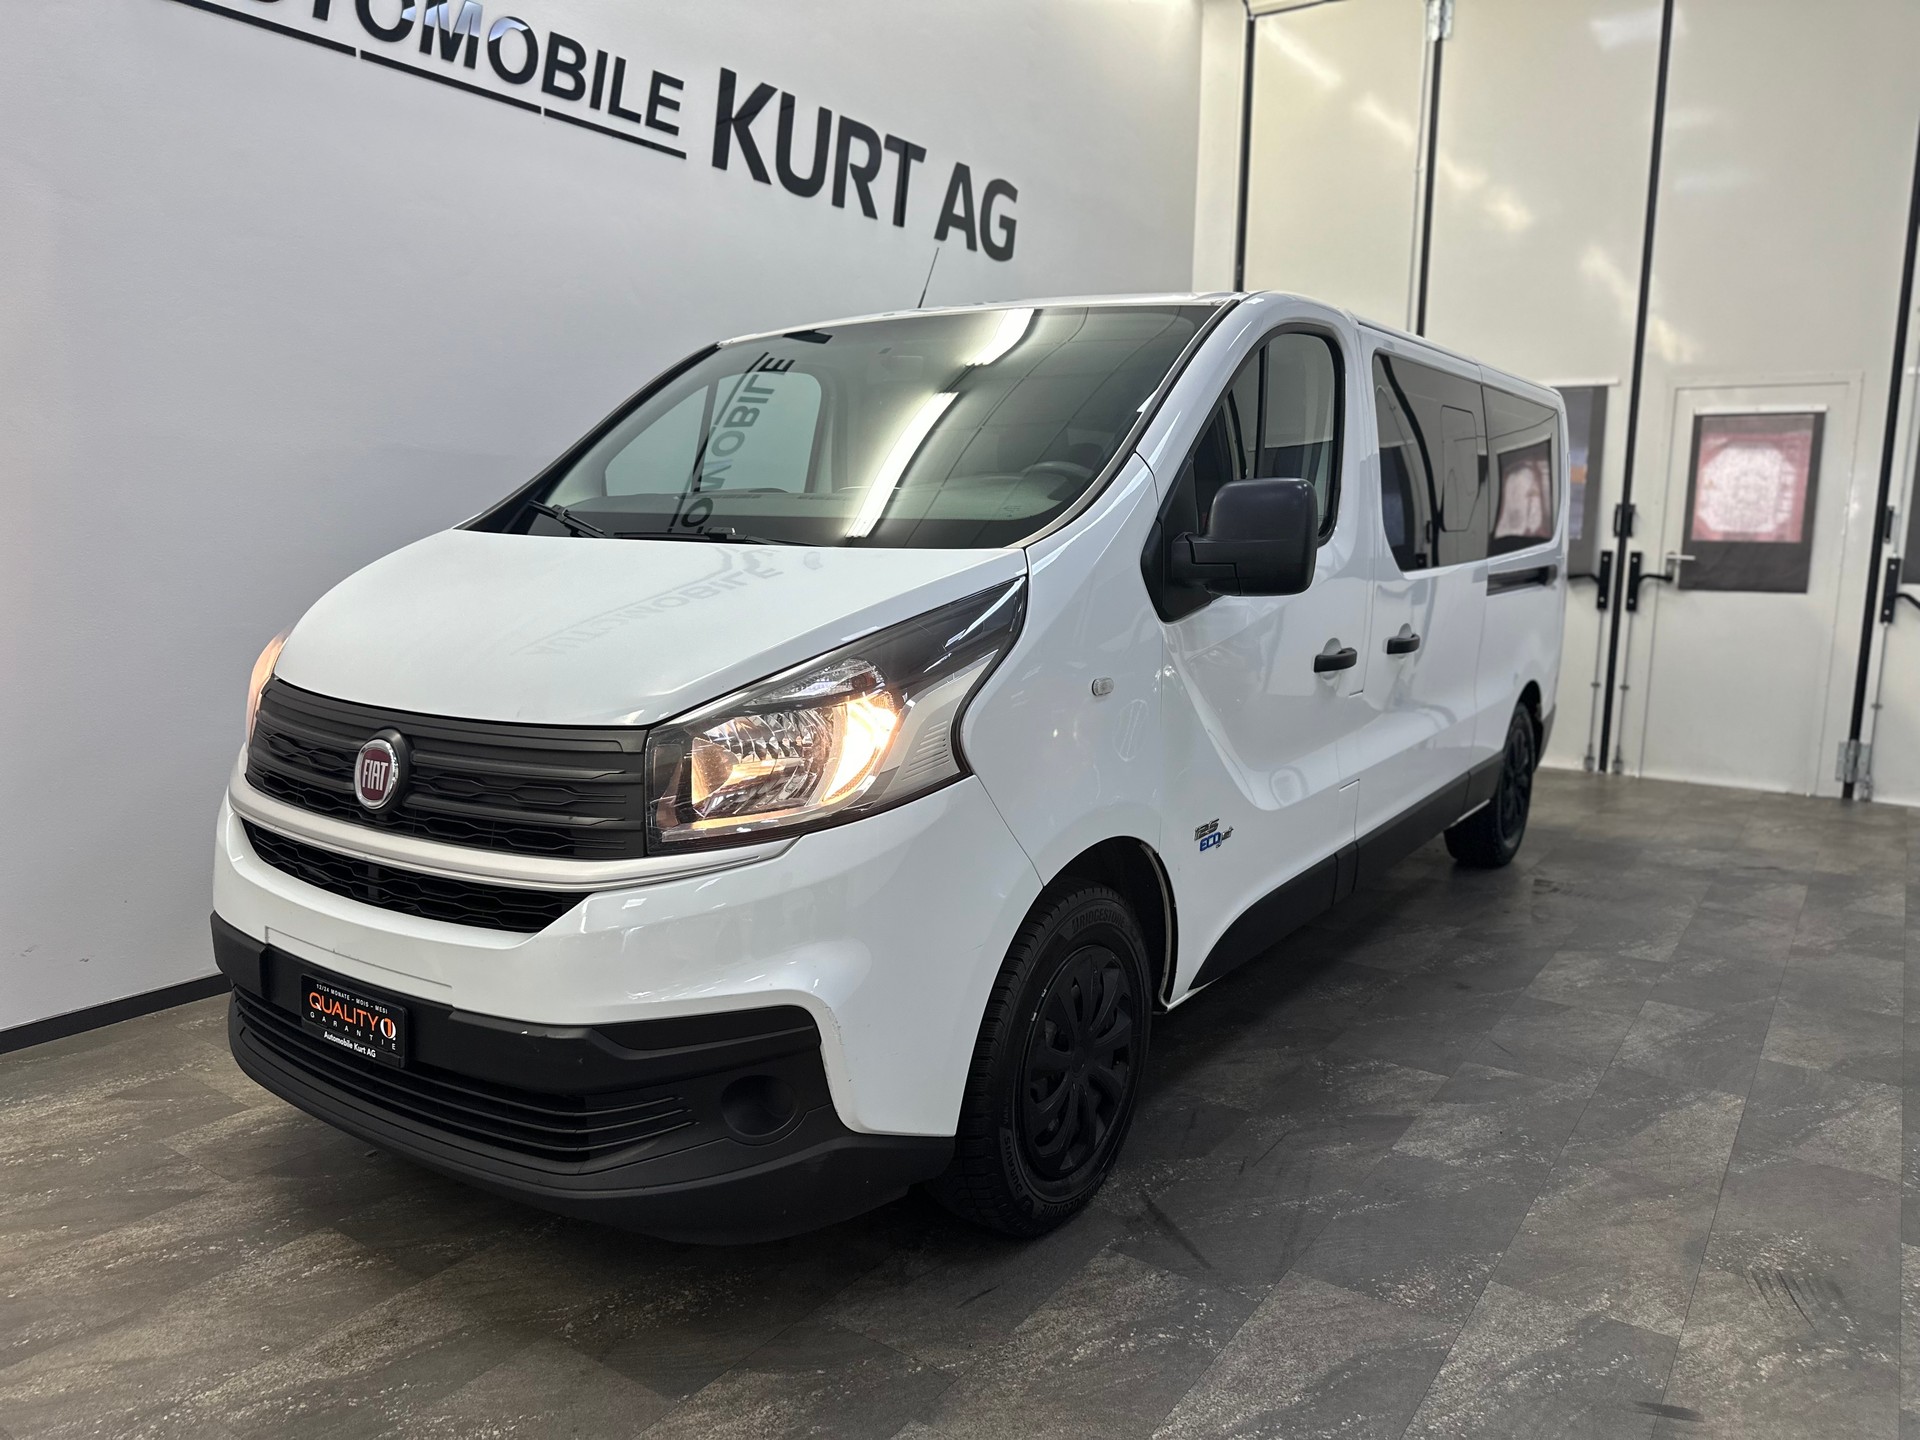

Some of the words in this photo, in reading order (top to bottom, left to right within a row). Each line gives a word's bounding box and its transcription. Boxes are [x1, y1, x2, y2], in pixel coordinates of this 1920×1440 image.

[243, 0, 684, 136] OMOBILE
[711, 67, 927, 228] KURT
[934, 161, 1018, 262] AG
[362, 758, 389, 791] FIAT
[330, 988, 350, 1001] MONATE
[356, 997, 369, 1008] MOIS
[375, 1005, 388, 1015] MESI
[310, 1011, 396, 1051] GARANTIE
[323, 1030, 353, 1049] Automobile
[353, 1042, 367, 1055] Kurt
[366, 1047, 377, 1058] AG
